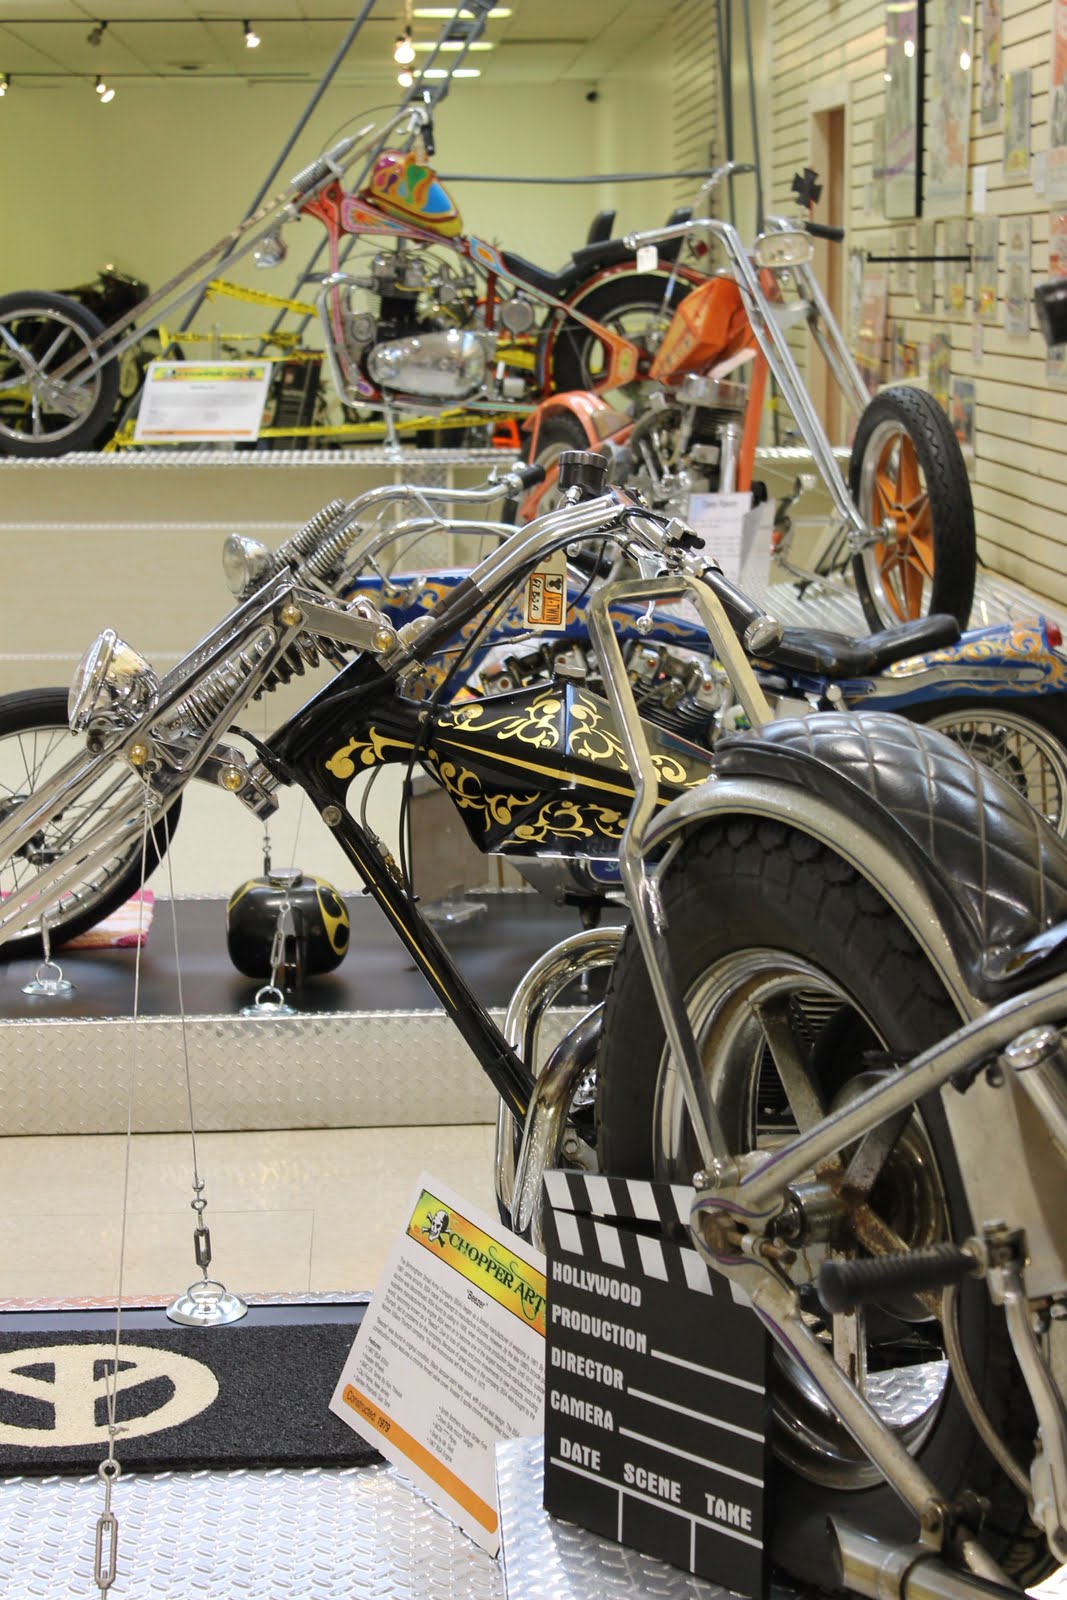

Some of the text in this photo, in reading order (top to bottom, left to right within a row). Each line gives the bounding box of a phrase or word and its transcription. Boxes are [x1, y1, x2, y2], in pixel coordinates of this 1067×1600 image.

[449, 1232, 514, 1290] CHOPPER
[552, 1260, 642, 1307] HOLLYWOOD
[551, 1303, 647, 1355] PRODUCTION
[551, 1346, 624, 1391] DIRECTOR
[376, 1415, 391, 1433] 1979
[550, 1389, 614, 1432] CAMERA
[559, 1436, 752, 1531] DATE SCENE TAKE
